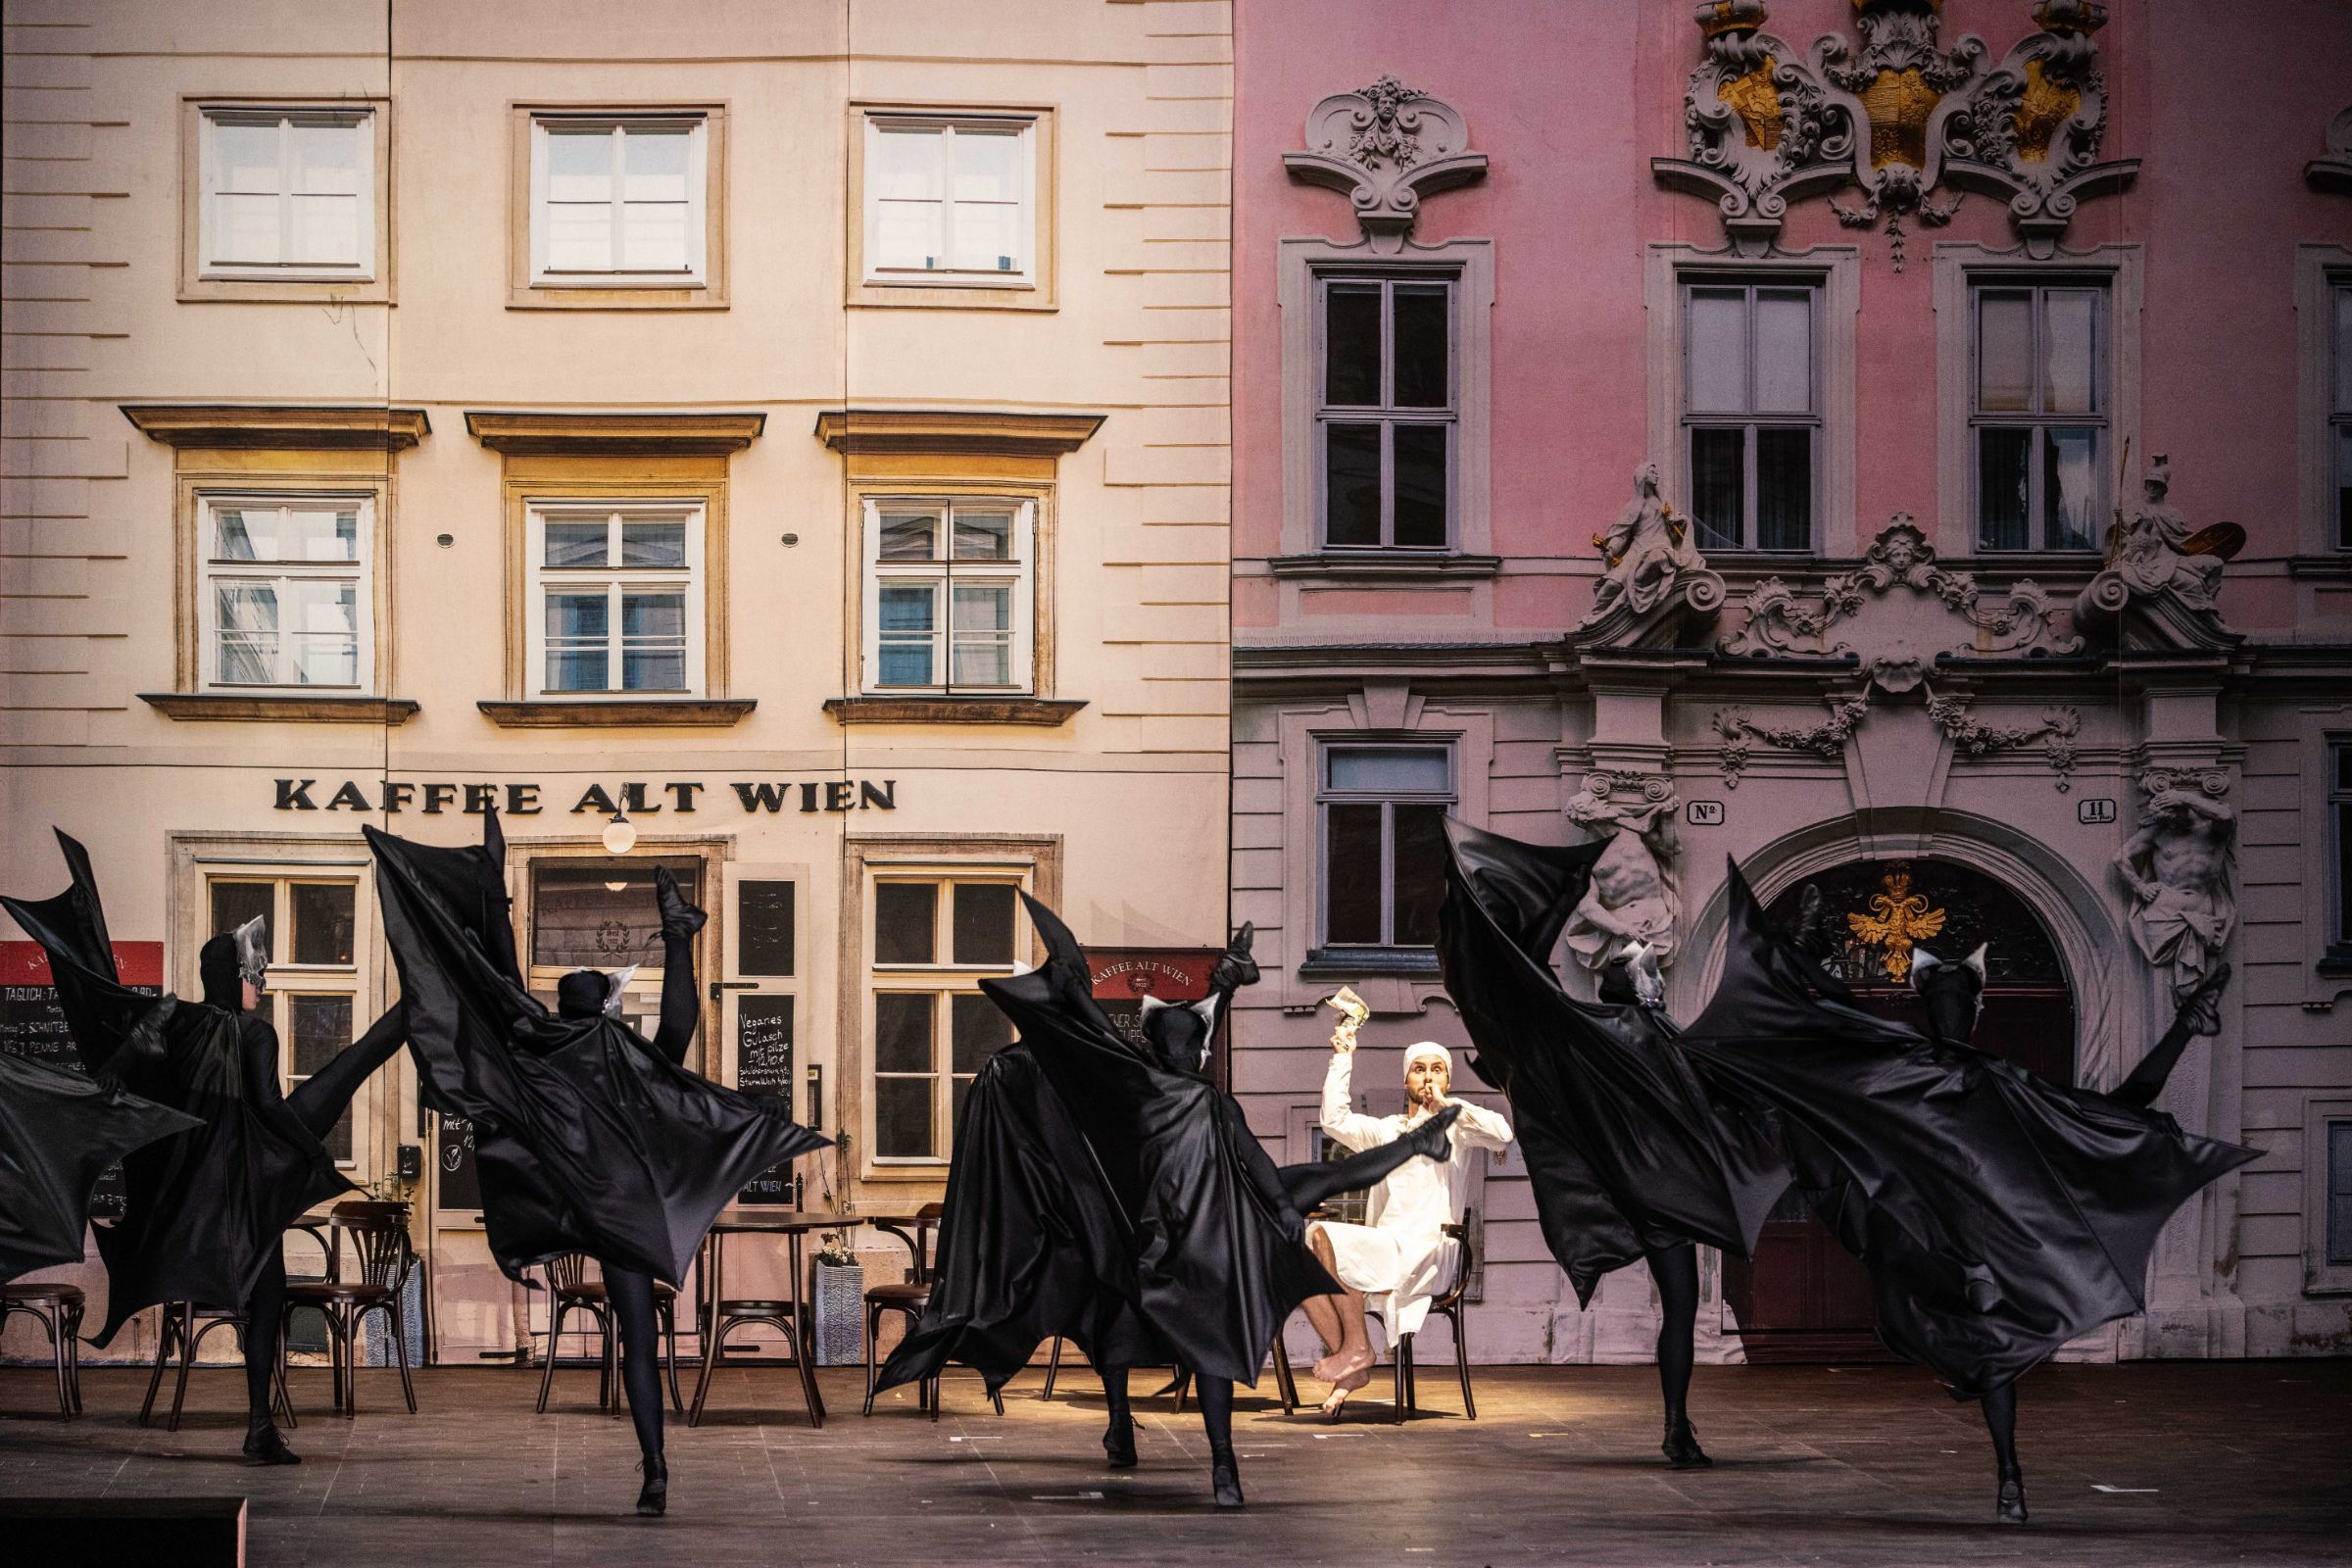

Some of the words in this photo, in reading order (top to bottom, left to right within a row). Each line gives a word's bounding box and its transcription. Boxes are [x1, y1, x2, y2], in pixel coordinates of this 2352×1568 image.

[272, 779, 543, 814] KAFFEE
[570, 782, 705, 813] ALT
[730, 780, 897, 812] WIEN
[2089, 801, 2104, 815] 11
[1091, 961, 1133, 986] KAFFEE
[1136, 961, 1159, 971] ALT
[1162, 964, 1194, 986] WIEN
[28, 1021, 71, 1034] SCHNITZE
[740, 1013, 782, 1035] Veganes
[743, 1029, 783, 1048] Gulasch
[750, 1046, 764, 1059] mit
[760, 1180, 782, 1193] WIEN
